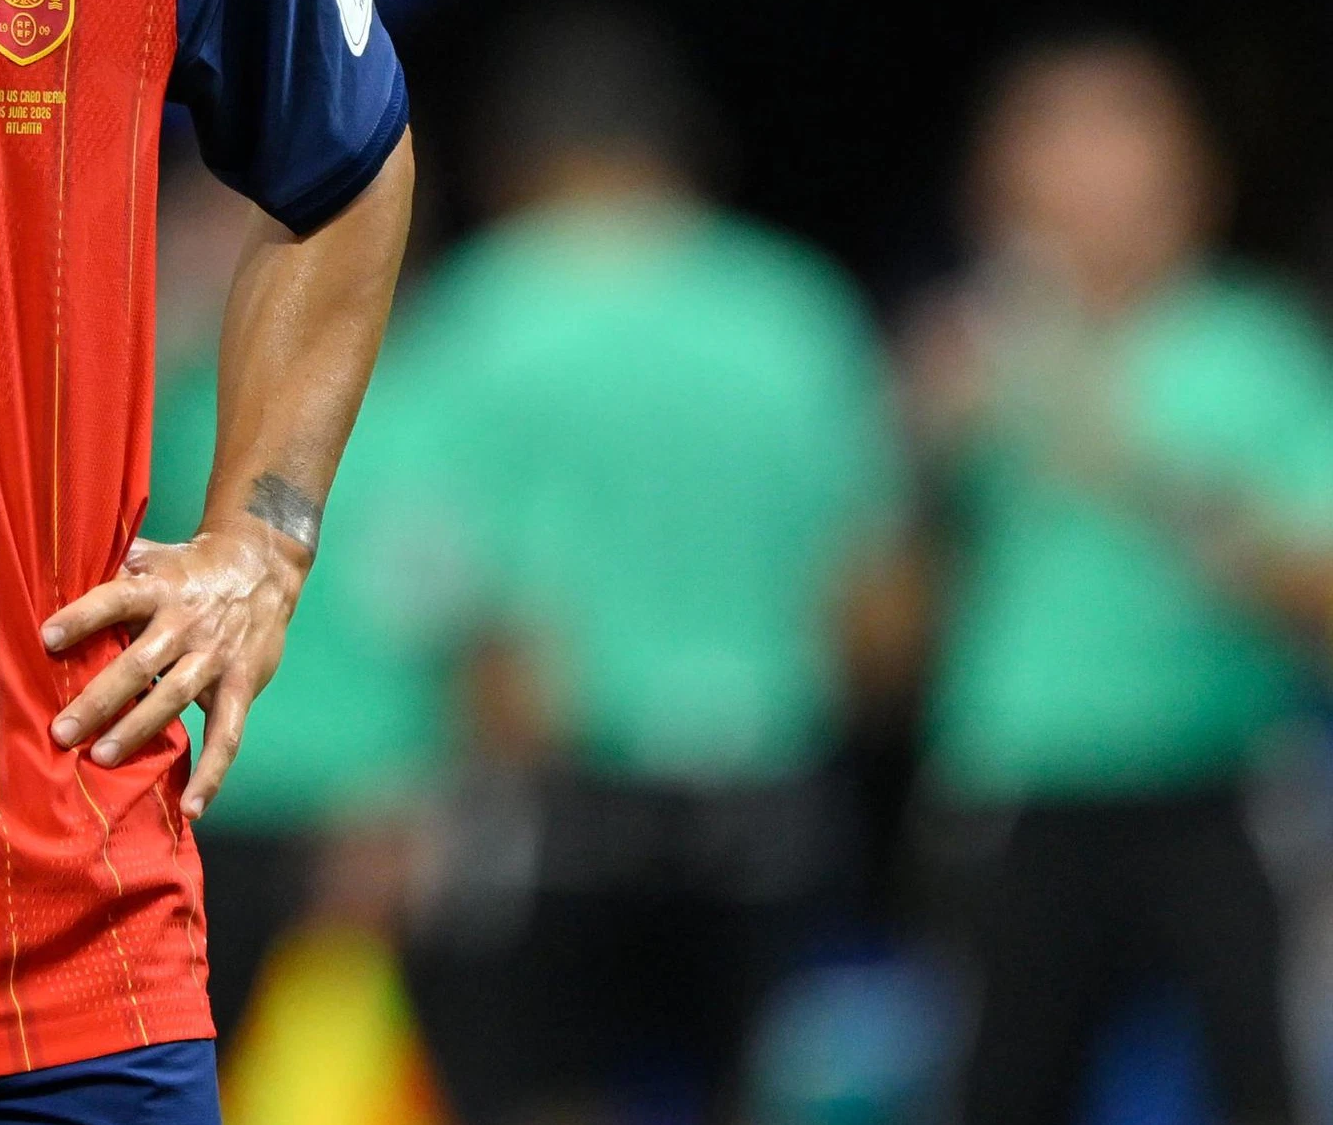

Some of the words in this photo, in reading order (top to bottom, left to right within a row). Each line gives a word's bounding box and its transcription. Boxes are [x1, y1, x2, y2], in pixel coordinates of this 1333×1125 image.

[20, 90, 41, 103] CABO
[7, 105, 28, 119] JUNE
[30, 106, 52, 119] 2026
[6, 122, 42, 134] ATLANTA
